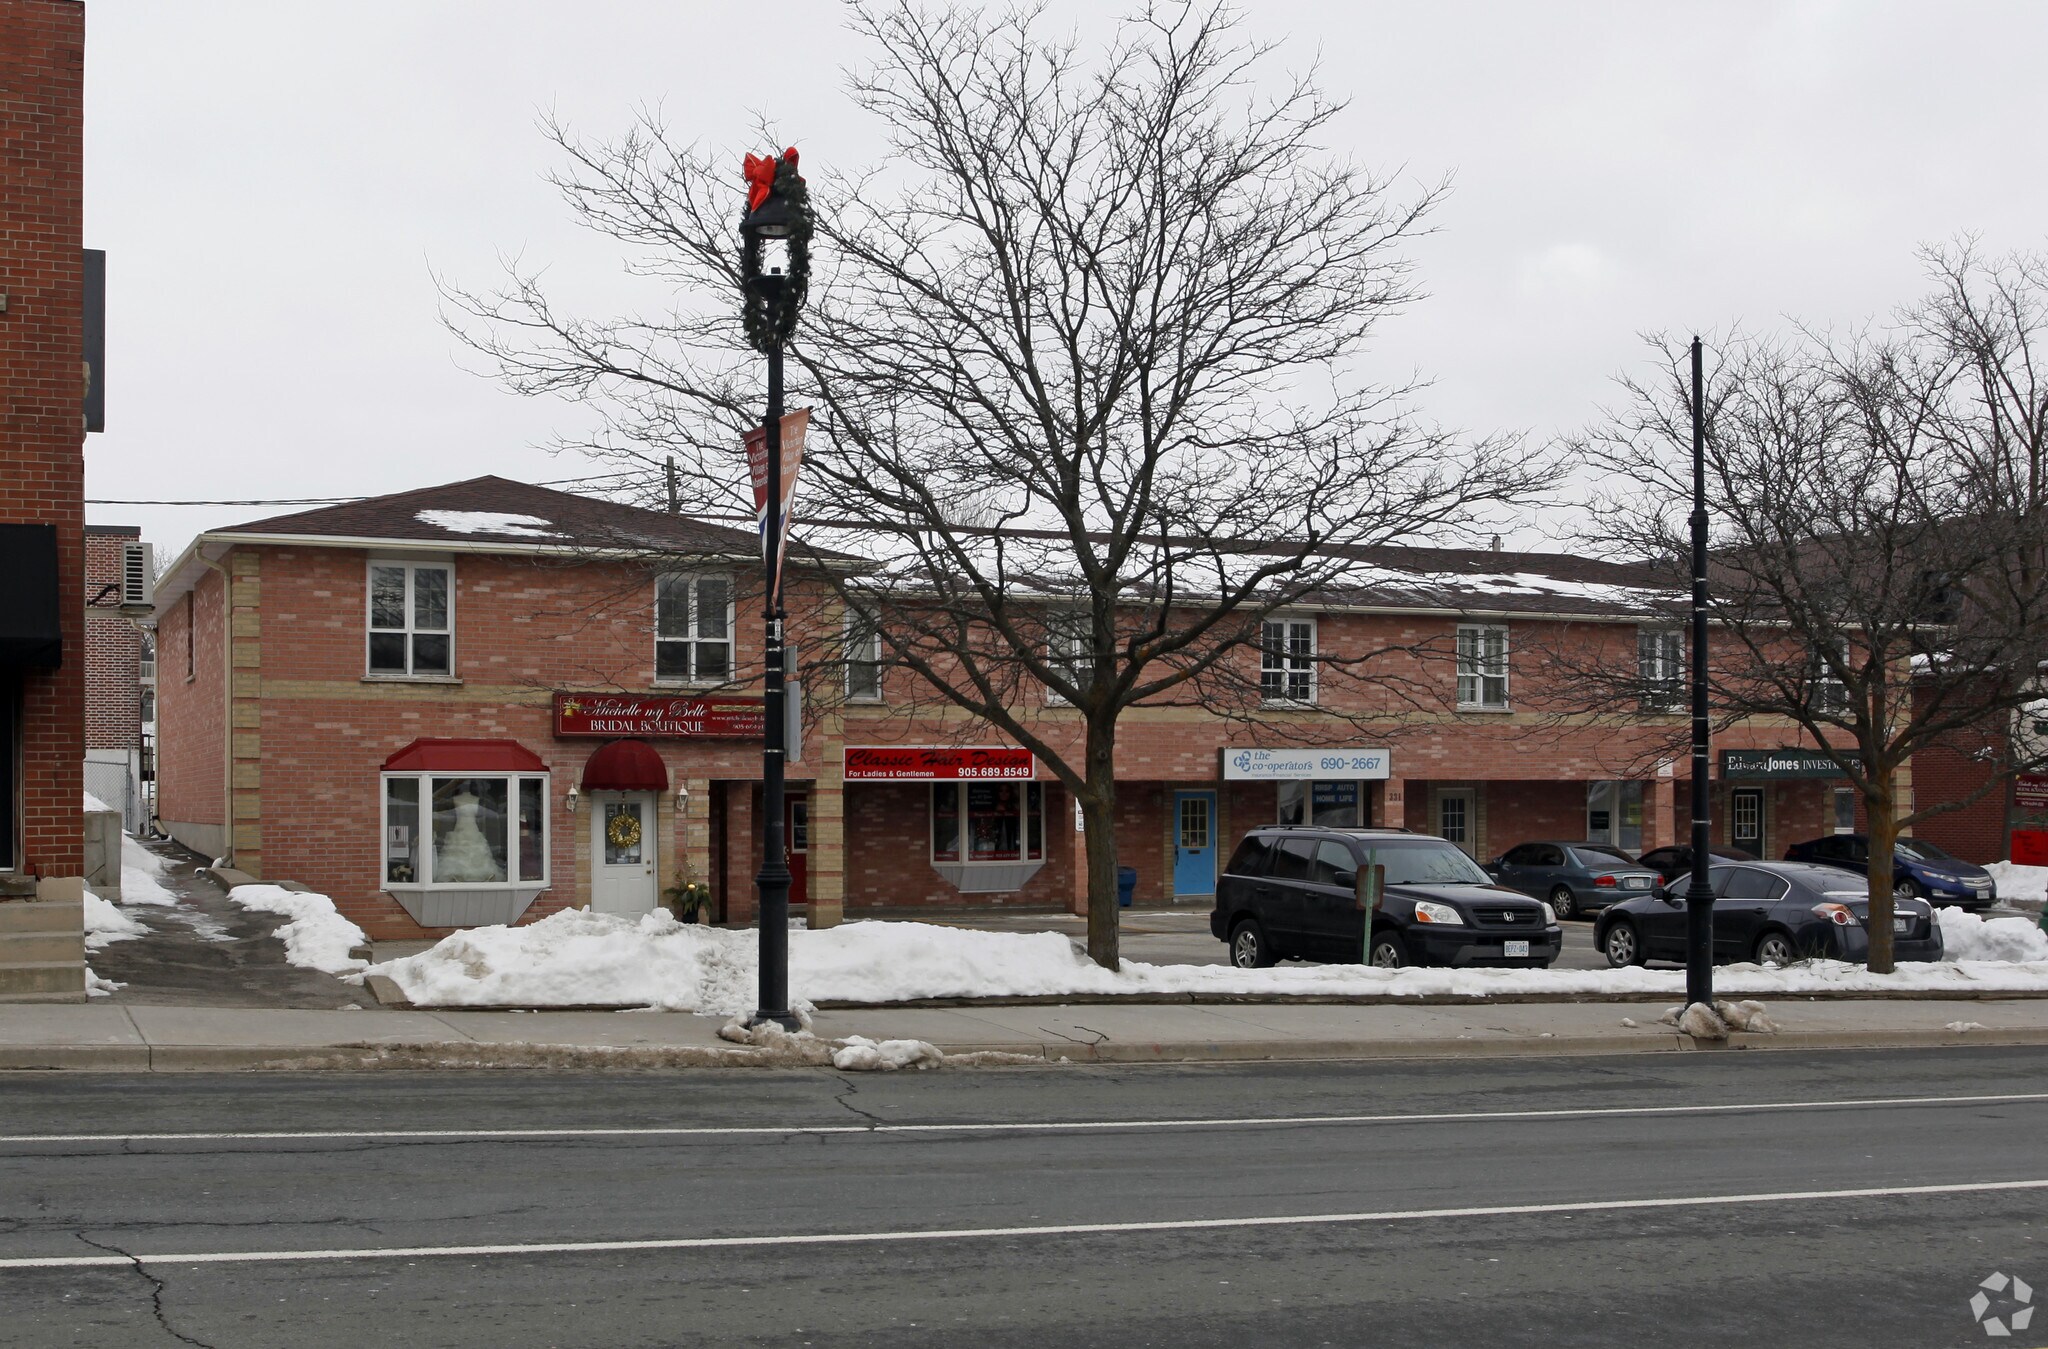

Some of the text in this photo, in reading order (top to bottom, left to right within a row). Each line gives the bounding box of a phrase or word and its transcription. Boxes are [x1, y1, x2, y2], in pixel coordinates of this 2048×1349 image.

[584, 699, 641, 716] Michelle
[644, 708, 663, 721] my
[668, 699, 707, 717] Belle
[590, 719, 704, 734] BRIDAL BOUTIQUE
[848, 750, 1028, 767] Classic Hair Design
[1254, 751, 1271, 761] the
[1252, 761, 1313, 773] co-operators
[1320, 757, 1381, 770] 690-2667
[958, 767, 1029, 777] 905.689.8549
